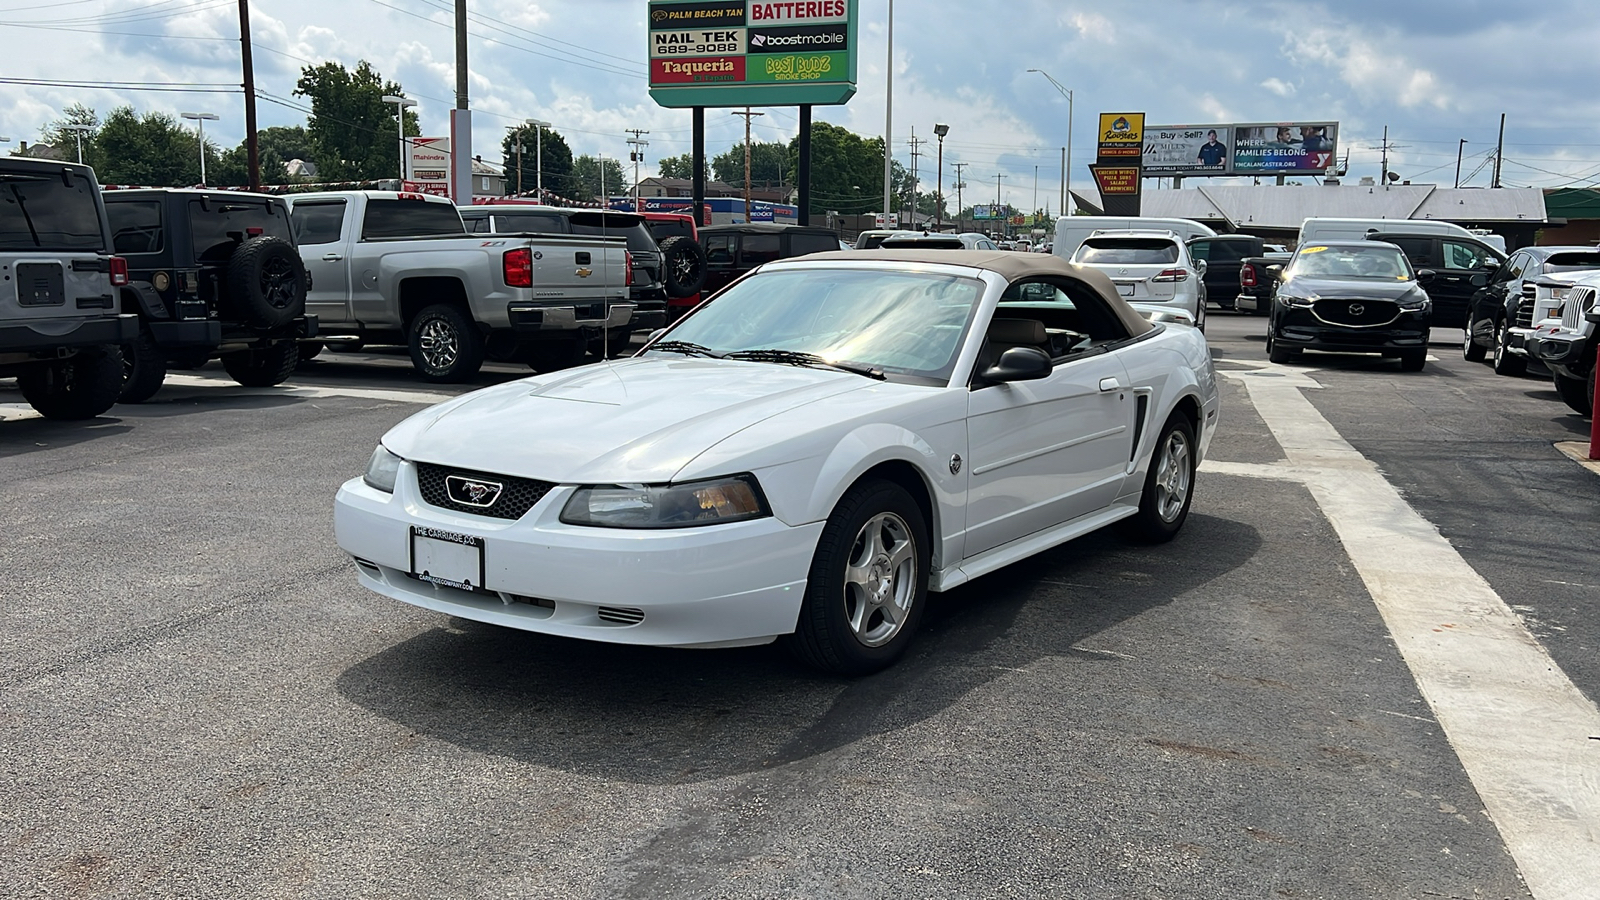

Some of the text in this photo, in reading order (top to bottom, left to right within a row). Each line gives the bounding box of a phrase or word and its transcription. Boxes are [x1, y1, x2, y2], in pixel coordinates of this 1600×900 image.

[669, 8, 743, 19] PALM BEACH TAN
[752, 0, 845, 20] BATTERIES
[655, 31, 738, 44] NAIL TEK
[657, 43, 737, 54] 689-9088
[775, 72, 820, 81] SMOKE SHOP
[1104, 130, 1138, 141] Roosters
[1160, 132, 1176, 140] Buy
[1184, 131, 1203, 139] Sell?
[415, 527, 477, 545] THE CARRIAGE CO.
